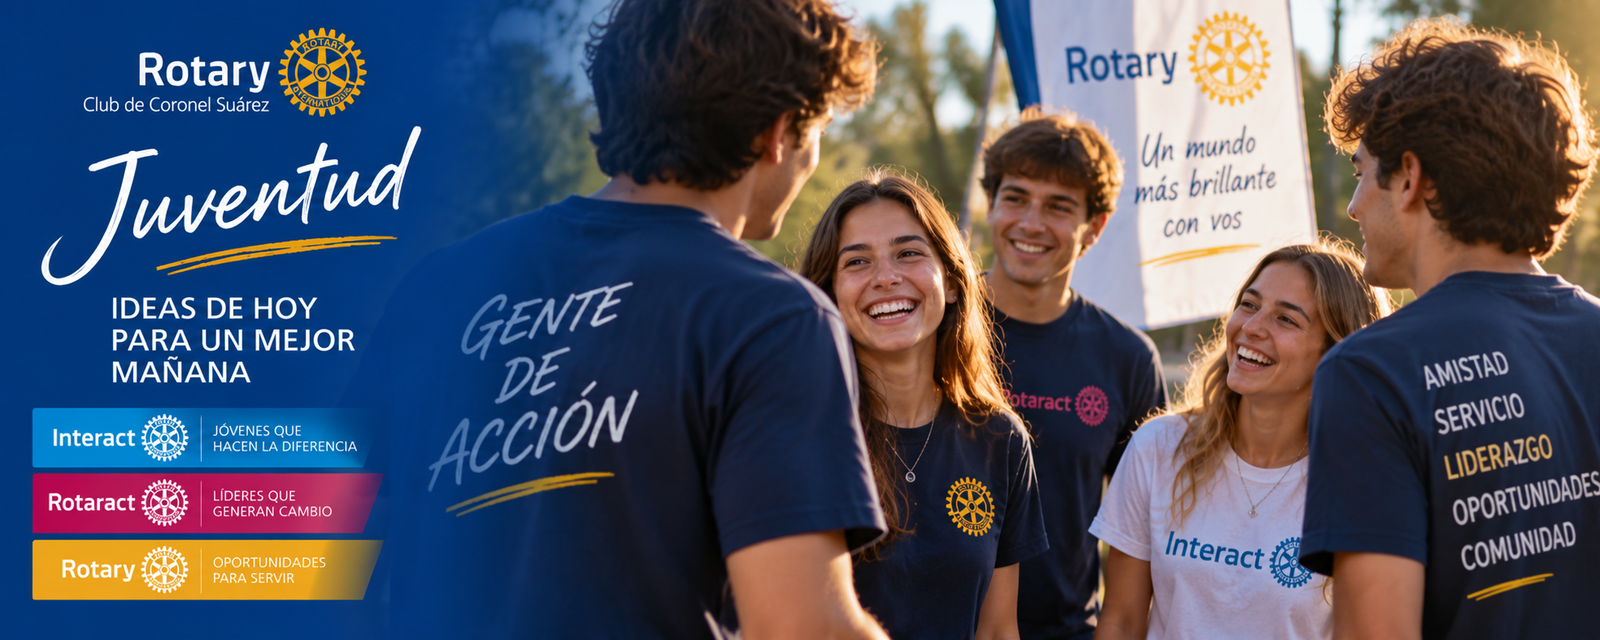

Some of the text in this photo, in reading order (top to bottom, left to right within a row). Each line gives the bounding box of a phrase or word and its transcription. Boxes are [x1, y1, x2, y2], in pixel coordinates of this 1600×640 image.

[1064, 46, 1179, 85] Rotary
[1141, 125, 1256, 168] Un mundo
[1134, 163, 1278, 204] más brillante
[1163, 210, 1243, 238] con vos
[460, 281, 634, 361] GENTE
[494, 346, 571, 404] DE
[1423, 351, 1510, 391] AMISTAD
[1433, 392, 1525, 435] SERVICIO
[427, 380, 639, 492] ACCIÓN
[1443, 433, 1553, 481] LIDERAZGO
[1452, 470, 1600, 526] OPORTUNIDADES
[1165, 531, 1265, 570] Interact
[1461, 521, 1576, 571] COMUNIDAD
